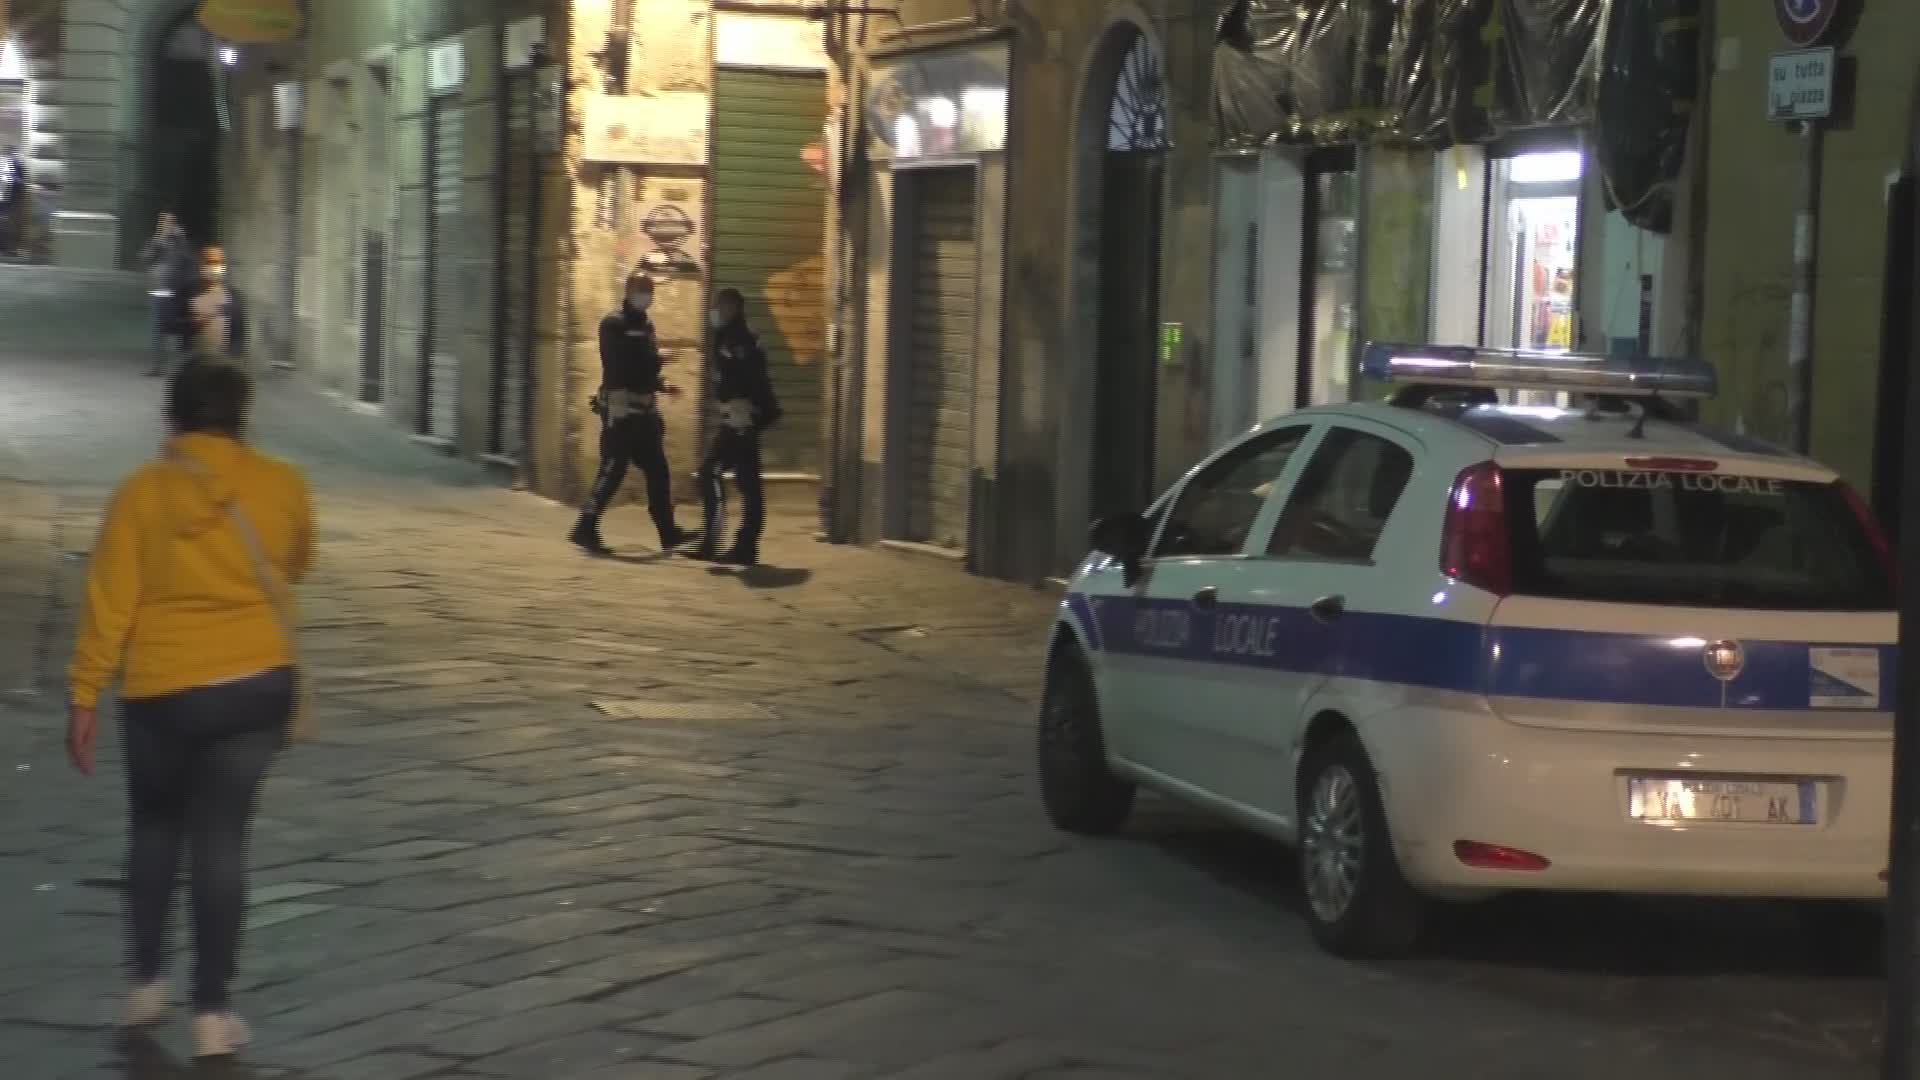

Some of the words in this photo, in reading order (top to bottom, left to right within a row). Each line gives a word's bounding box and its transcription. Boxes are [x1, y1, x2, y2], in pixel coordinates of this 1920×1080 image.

[1795, 61, 1824, 79] tutta
[1791, 88, 1825, 105] piazza
[1559, 469, 1673, 489] POLIZIA
[1680, 473, 1785, 496] LOCALE
[1213, 613, 1280, 656] LOCALE
[1767, 796, 1791, 822] AK
